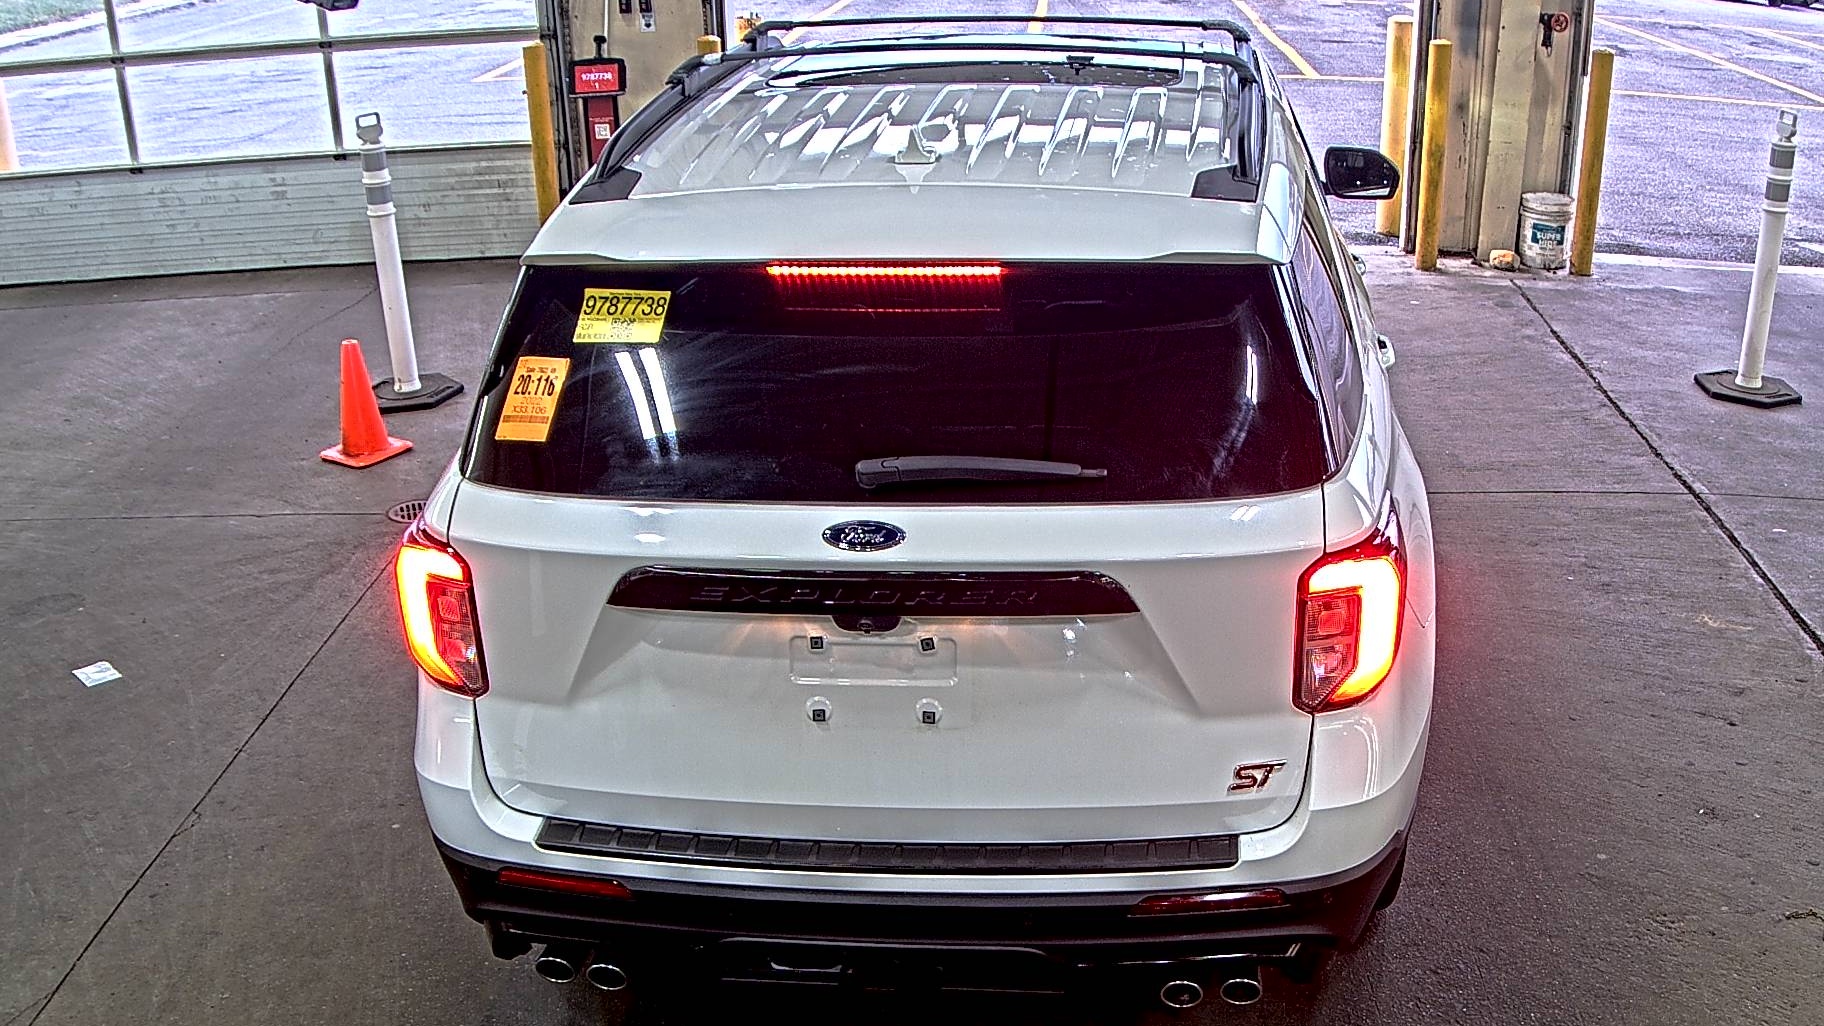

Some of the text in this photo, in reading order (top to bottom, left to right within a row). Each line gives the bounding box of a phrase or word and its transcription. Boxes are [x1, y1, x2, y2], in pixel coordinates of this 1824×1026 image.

[581, 72, 613, 81] 9787738
[583, 295, 668, 317] 9787738
[513, 374, 556, 397] 20:116
[841, 525, 887, 543] Ford
[689, 586, 1038, 605] EXPLORER
[1226, 758, 1288, 792] ST
